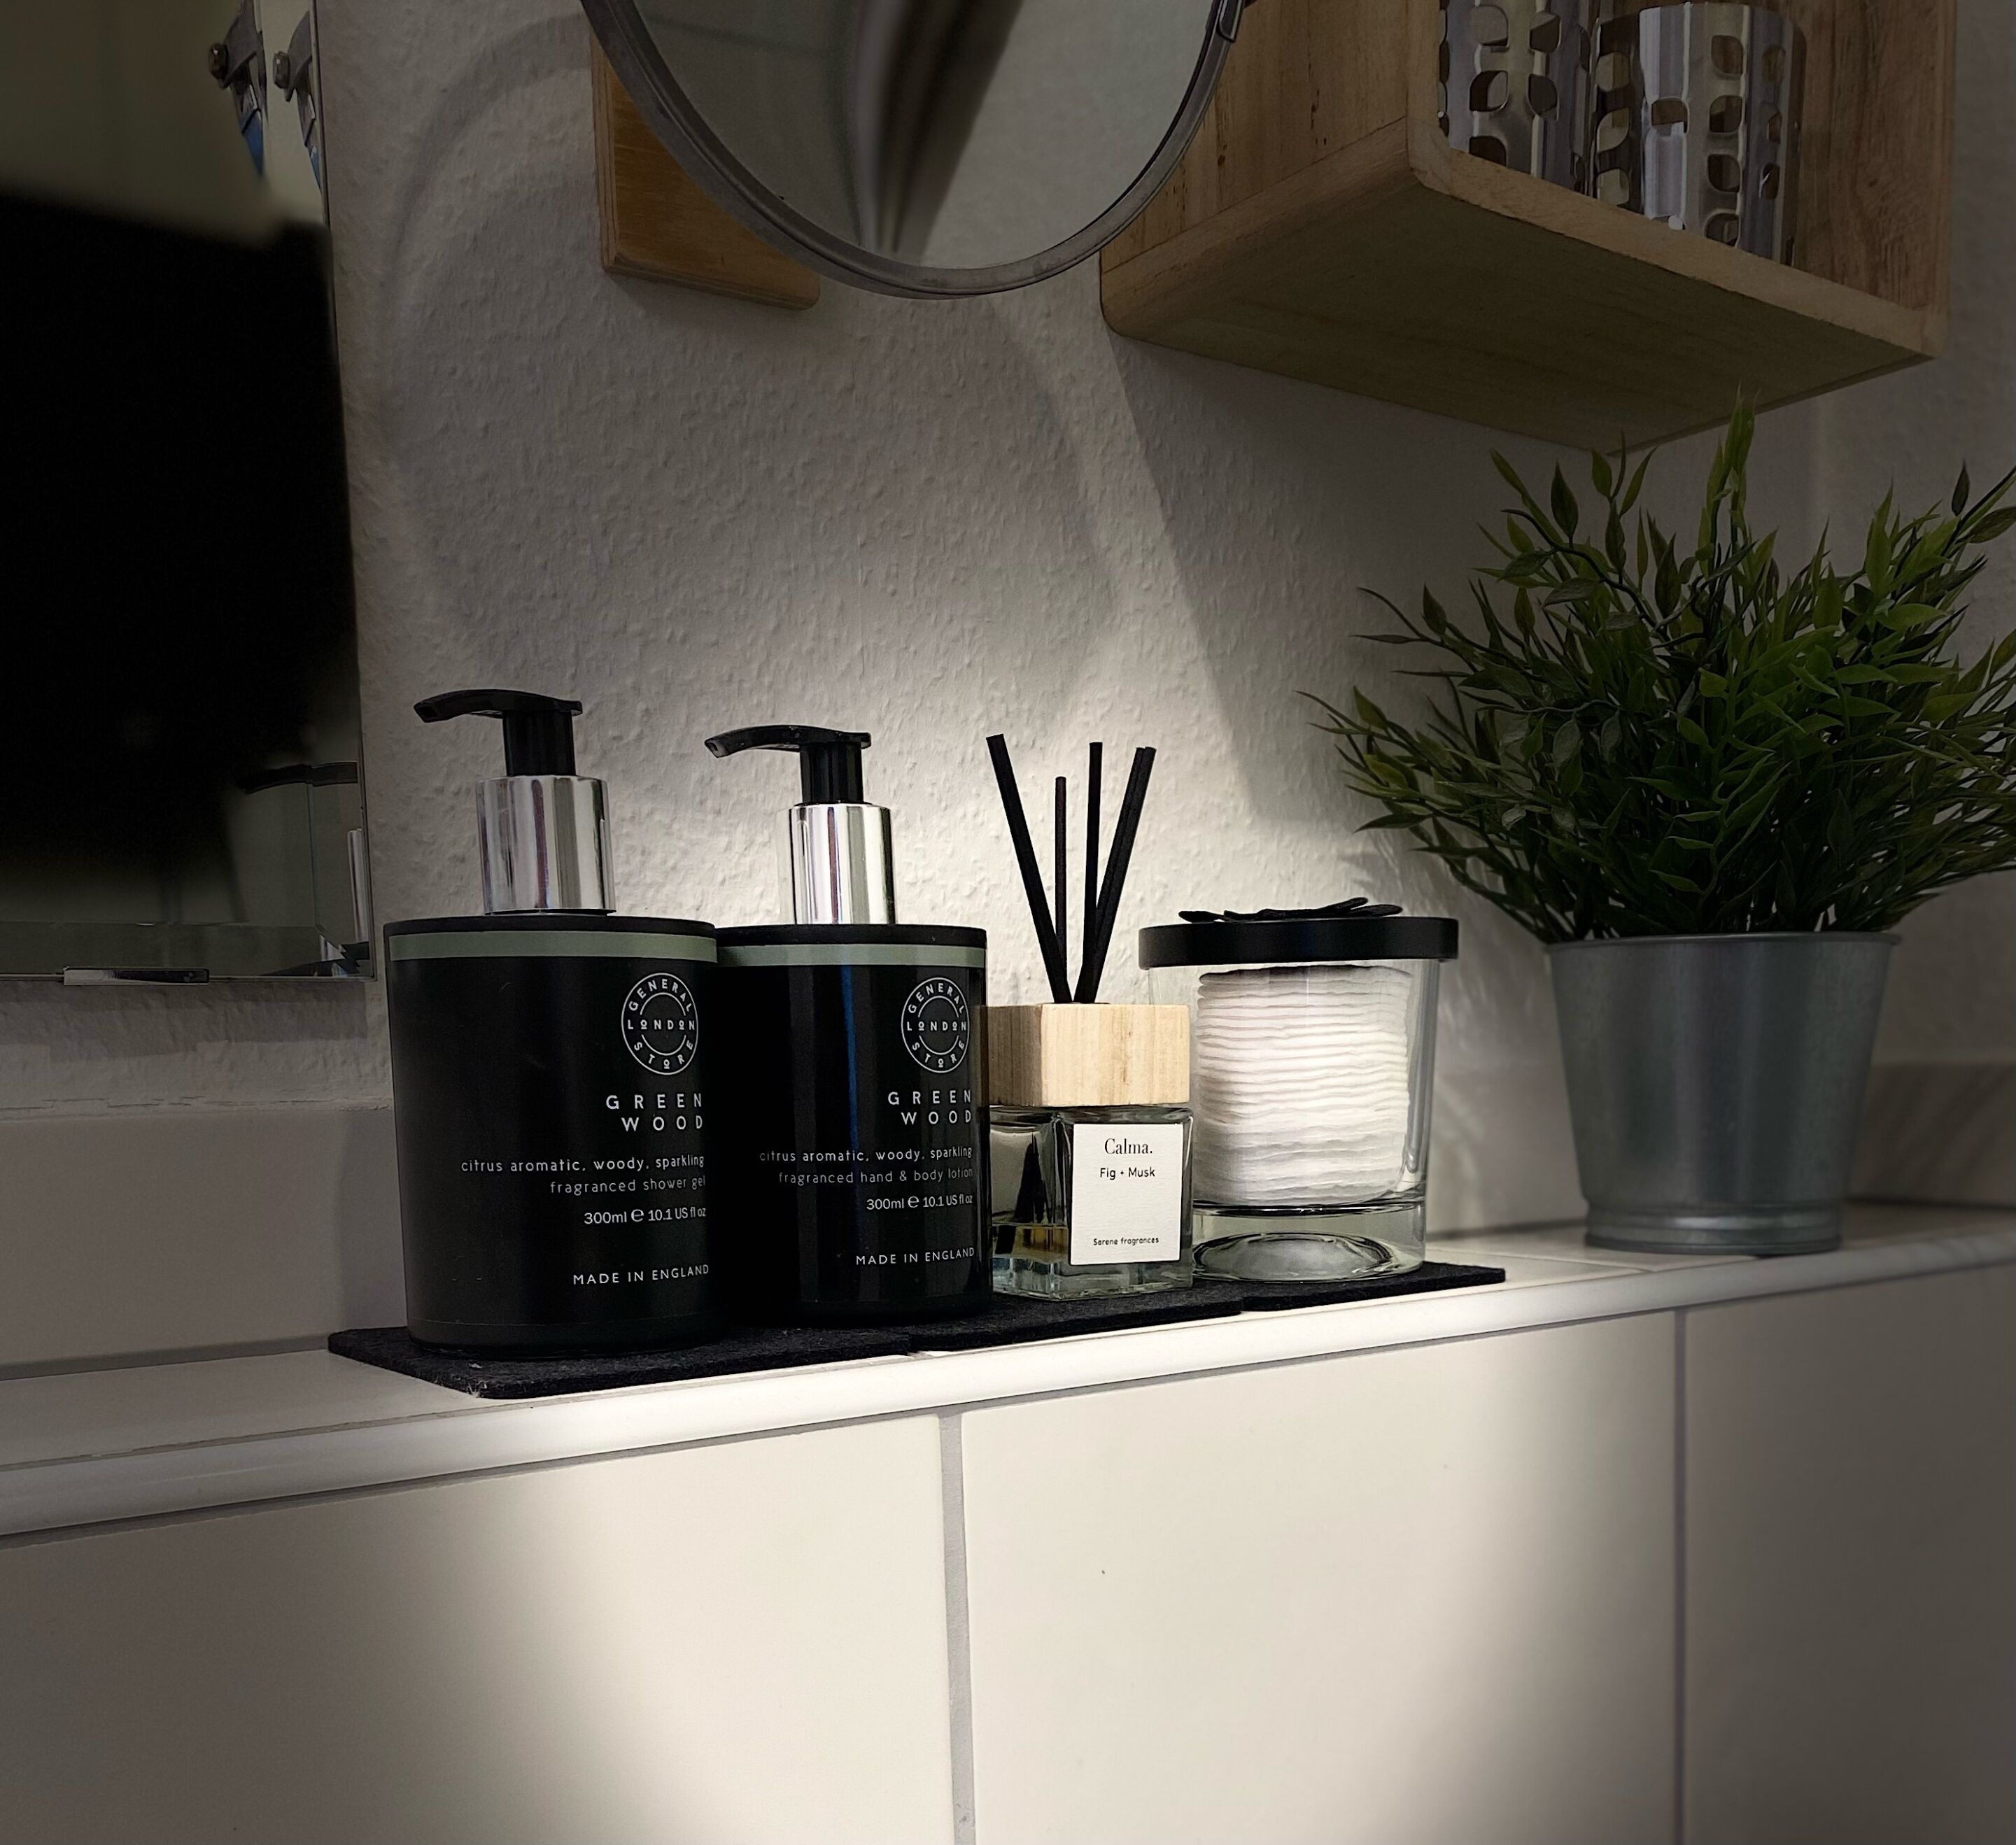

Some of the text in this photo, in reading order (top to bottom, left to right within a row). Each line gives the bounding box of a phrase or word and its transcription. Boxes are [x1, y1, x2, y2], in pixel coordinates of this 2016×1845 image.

[628, 979, 692, 1012] GENERAL
[908, 983, 964, 1014] GENERAL
[606, 1093, 702, 1110] GREEN
[887, 1089, 971, 1105] GREEN
[621, 1115, 703, 1132] WOOD
[901, 1110, 972, 1125] WOOD
[760, 1146, 972, 1161] citrus aromatic, woody, sparkling
[1104, 1138, 1152, 1154] Calma.
[461, 1154, 704, 1172] citrus aromatic, woody, sparkling
[779, 1167, 973, 1186] fragranced hand & body lotion
[1100, 1168, 1116, 1180] Fig
[1128, 1167, 1155, 1178] Musk
[551, 1175, 706, 1196] fragranced shower gel
[866, 1197, 904, 1210] 300ml
[923, 1196, 944, 1208] 10.1
[946, 1194, 957, 1206] US
[965, 1194, 973, 1204] oz
[584, 1212, 627, 1224] 300ml
[648, 1209, 672, 1222] 10.1
[675, 1208, 688, 1219] US
[690, 1207, 696, 1218] fl
[697, 1208, 706, 1217] oz
[1121, 1237, 1159, 1247] fragrances
[857, 1247, 975, 1265] MADE IN ENGLAND
[573, 1264, 709, 1285] MADE IN ENGLAND
